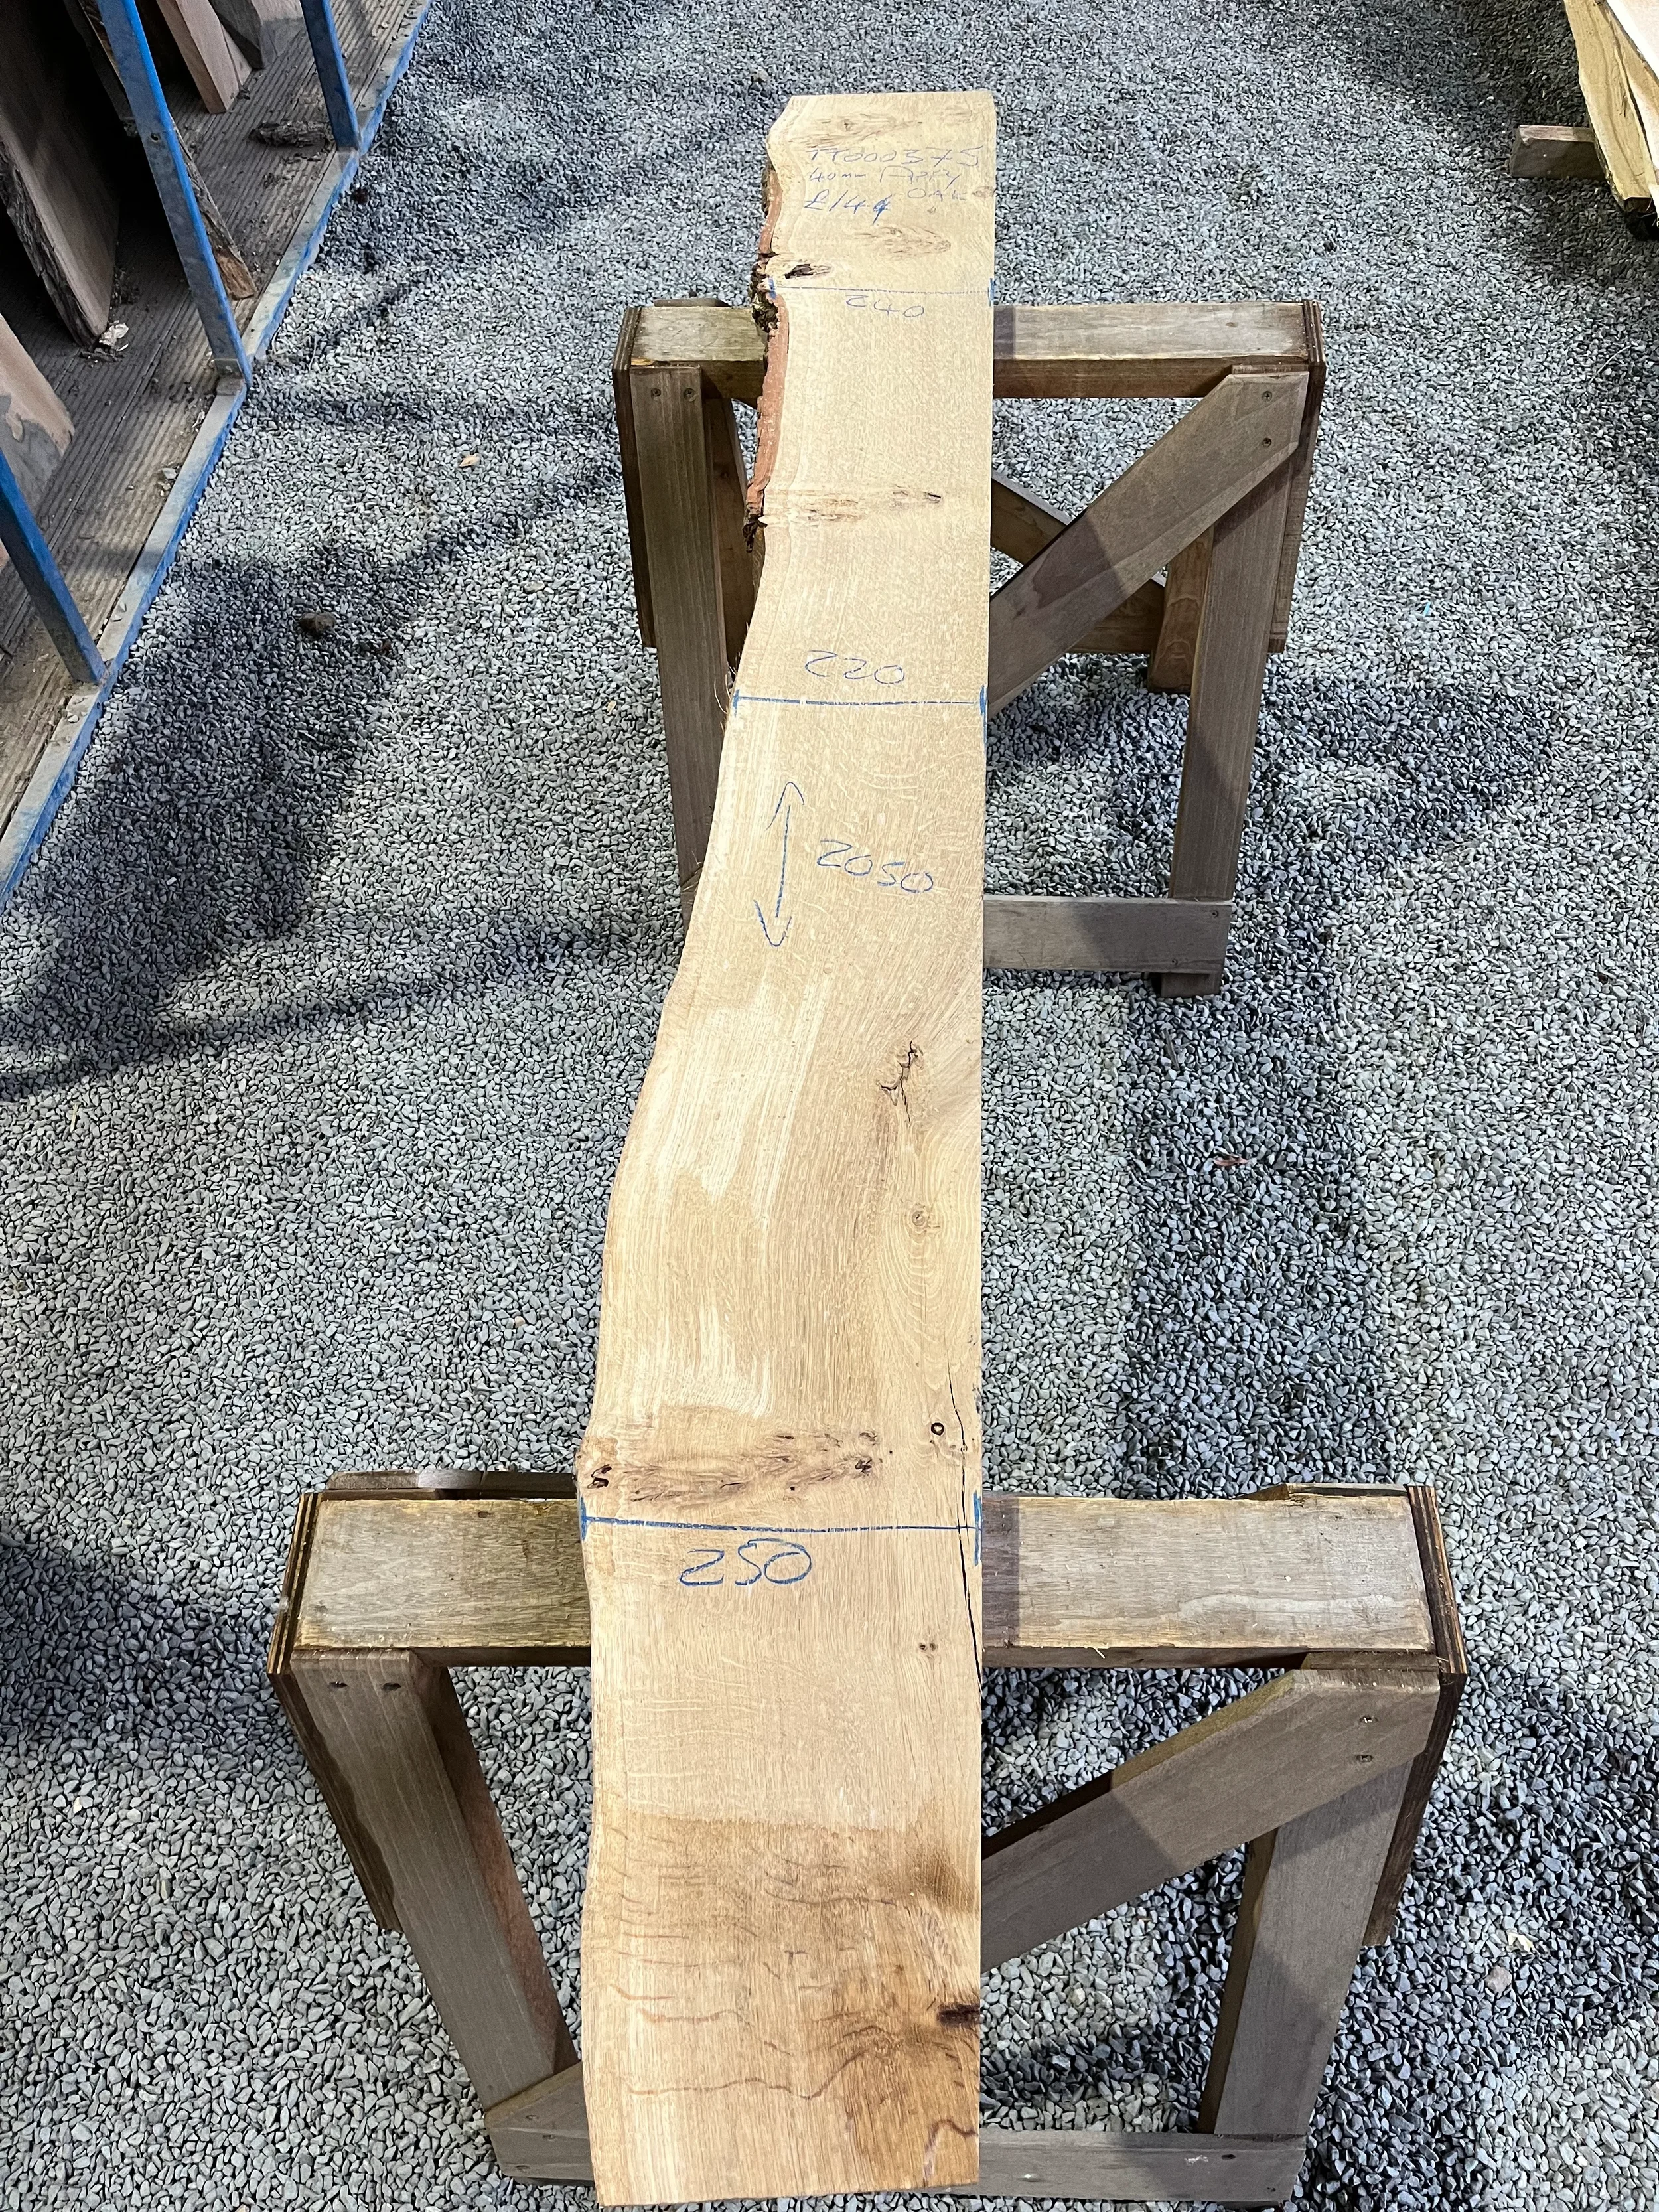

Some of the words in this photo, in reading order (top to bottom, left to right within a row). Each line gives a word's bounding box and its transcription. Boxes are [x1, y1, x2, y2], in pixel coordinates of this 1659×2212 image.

[845, 294, 924, 318] 240
[804, 650, 905, 684] 220
[816, 838, 934, 893] 2050
[678, 1537, 812, 1587] 250
